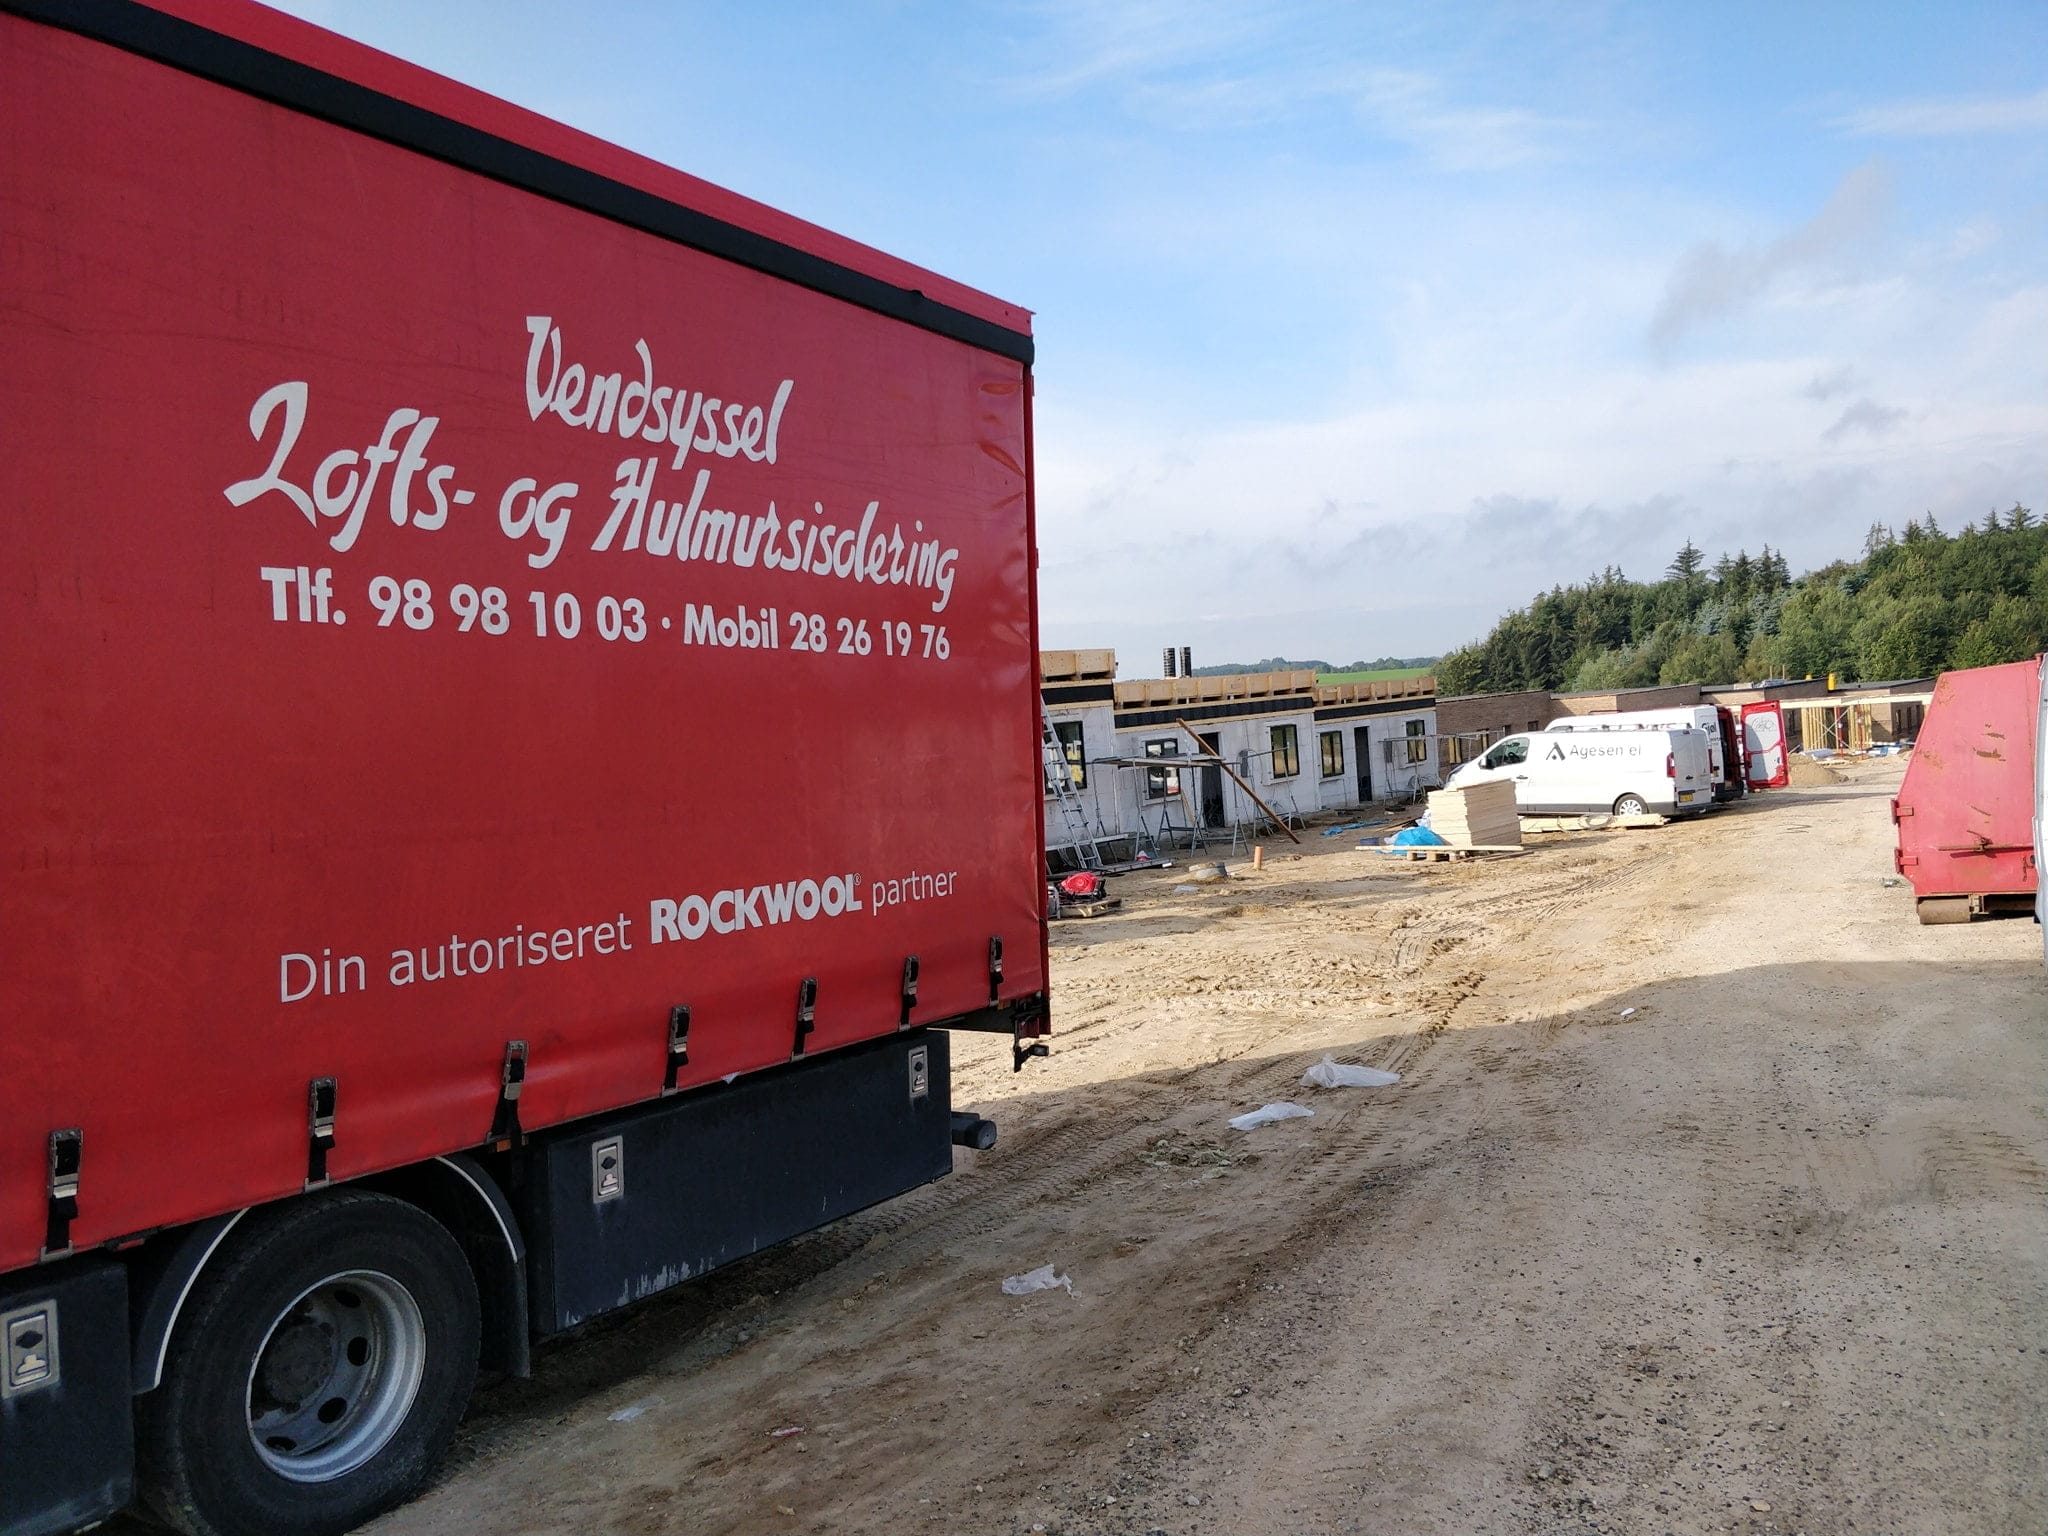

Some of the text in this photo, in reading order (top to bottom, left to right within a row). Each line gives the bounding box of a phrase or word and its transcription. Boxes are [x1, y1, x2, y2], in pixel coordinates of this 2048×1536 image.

[525, 316, 793, 469] Vendsyssel
[223, 381, 959, 613] Lofts- og Hulmursisolering
[260, 566, 950, 660] Tlf. 98 98 10 03 Mobil 28 26 19 76
[1569, 744, 1623, 760] Agesen
[281, 953, 366, 1003] Din
[390, 913, 632, 986] autoriseret
[872, 870, 957, 916] partner
